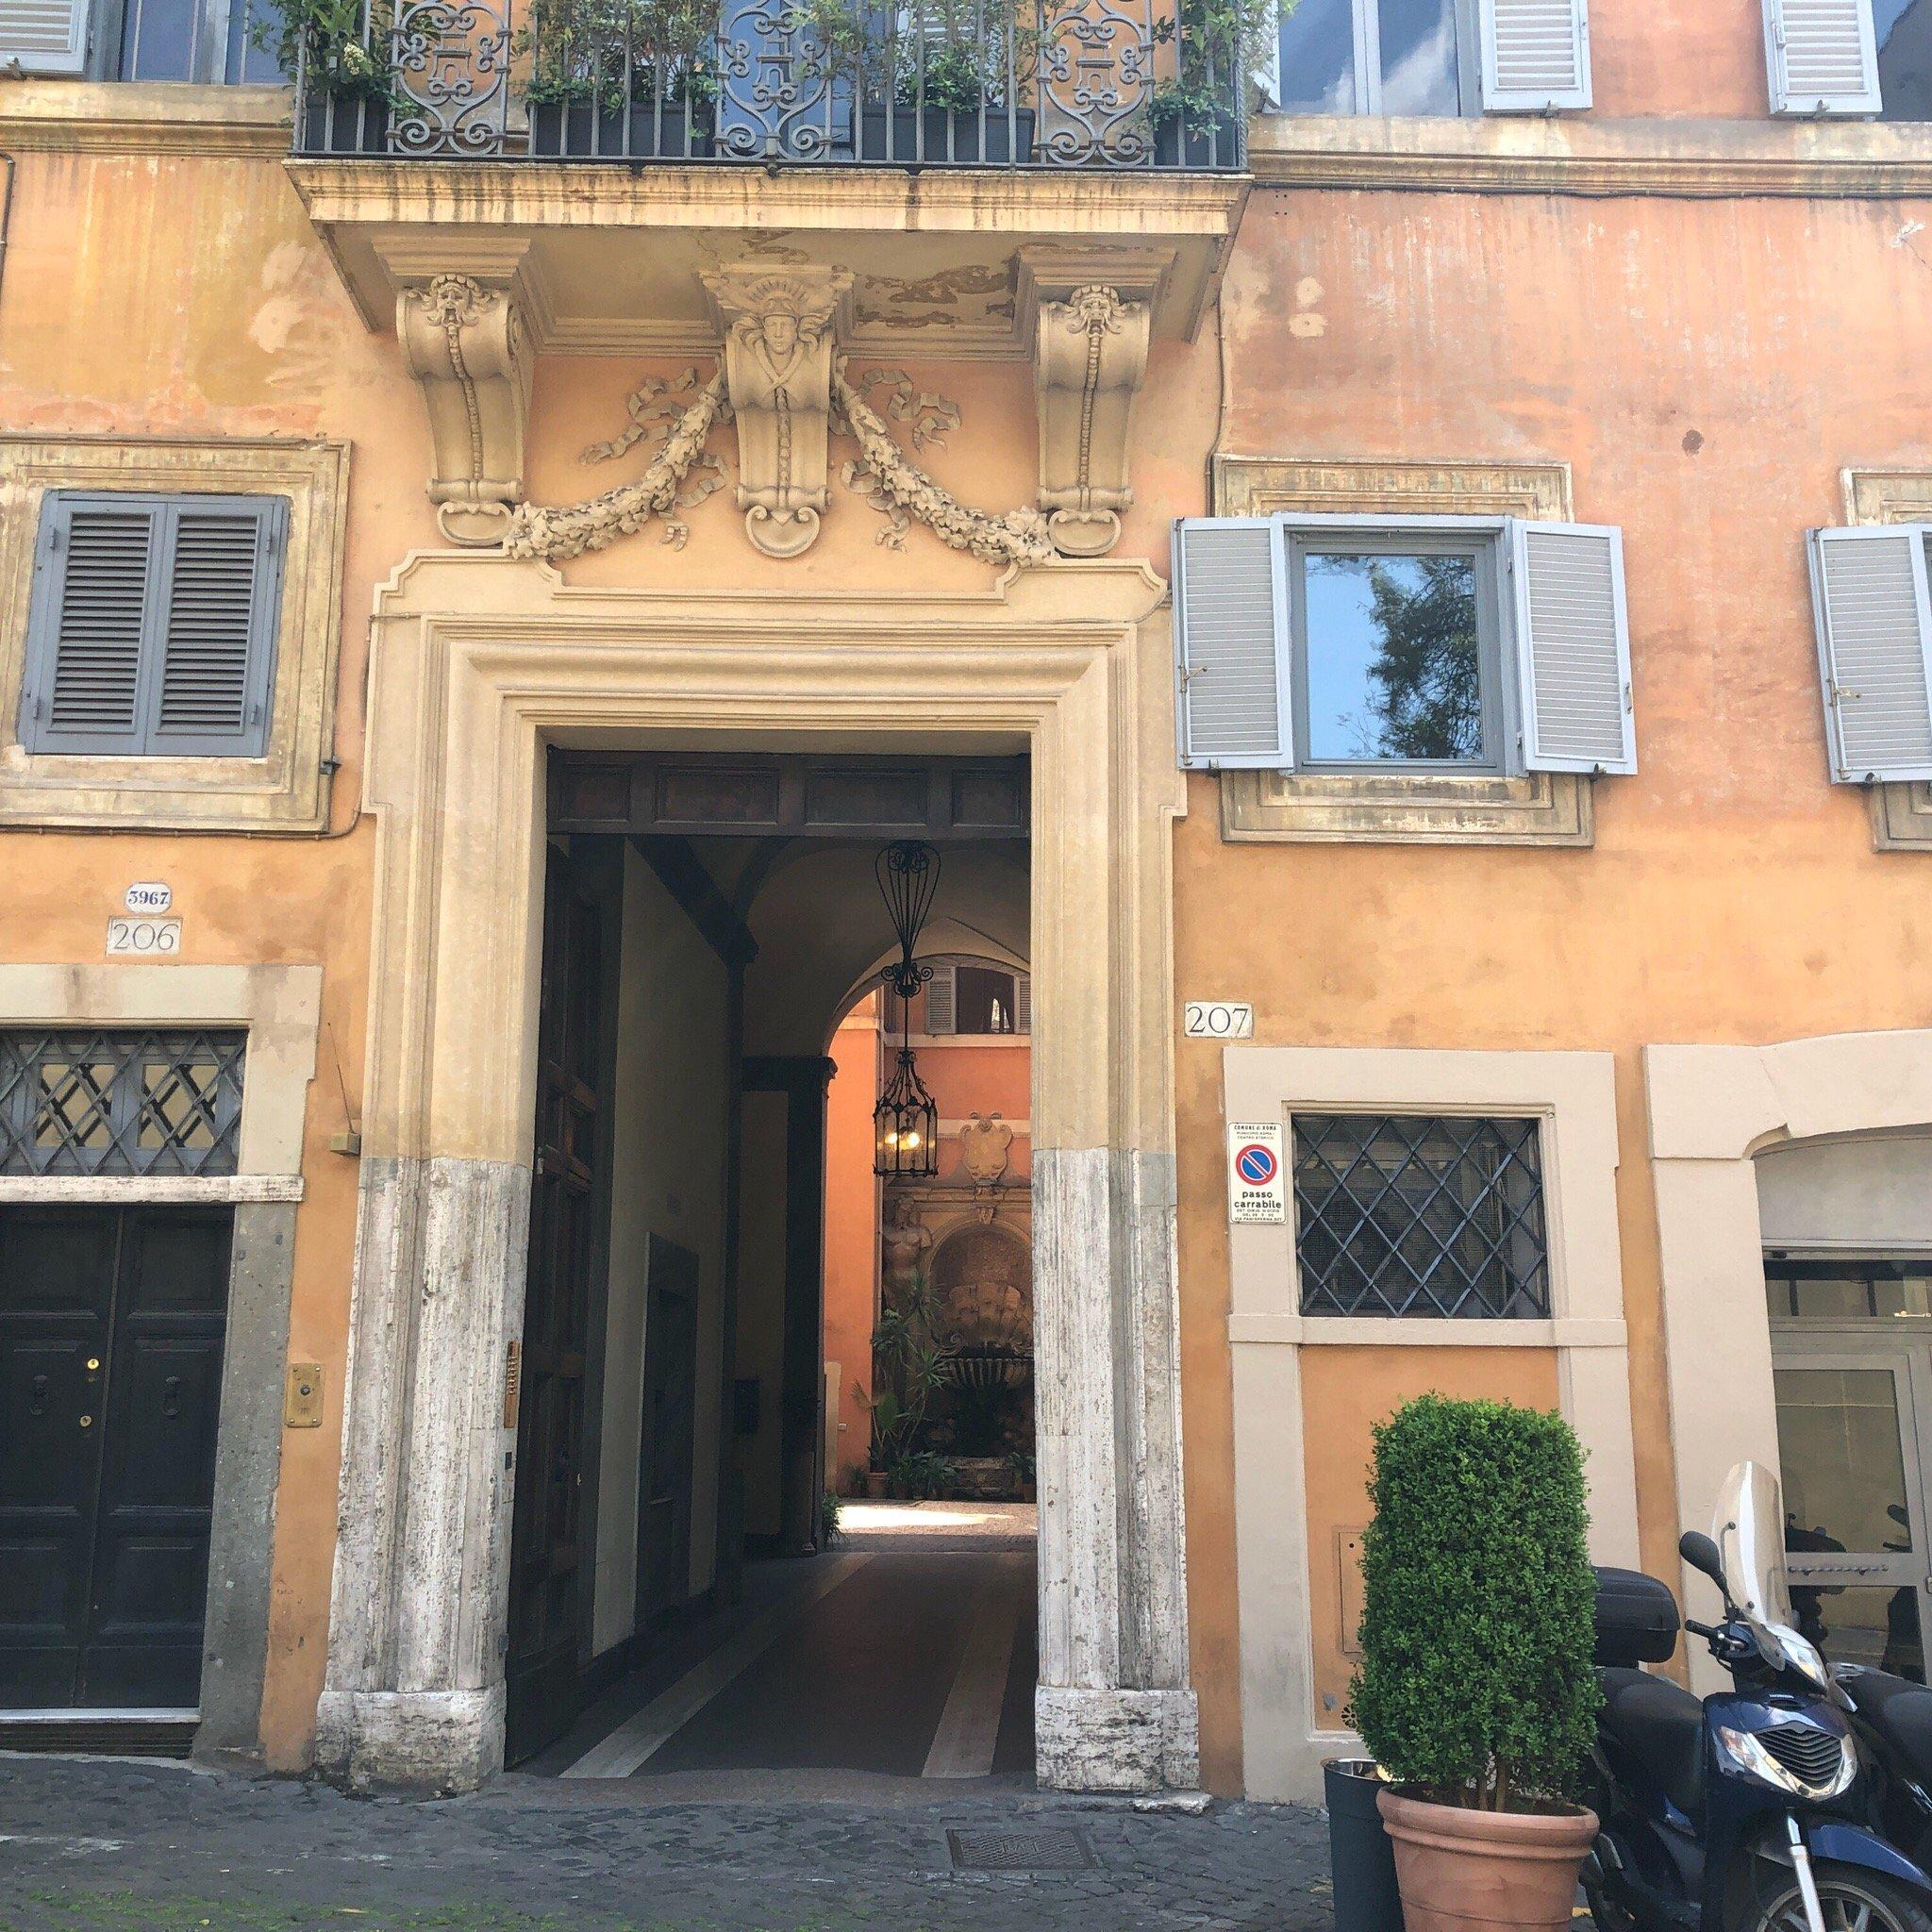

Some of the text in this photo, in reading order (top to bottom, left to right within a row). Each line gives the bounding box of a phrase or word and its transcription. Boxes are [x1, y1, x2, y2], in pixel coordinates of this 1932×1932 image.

[113, 924, 179, 950] 206
[1187, 1006, 1248, 1034] 207
[1234, 1200, 1282, 1208] carrabile
